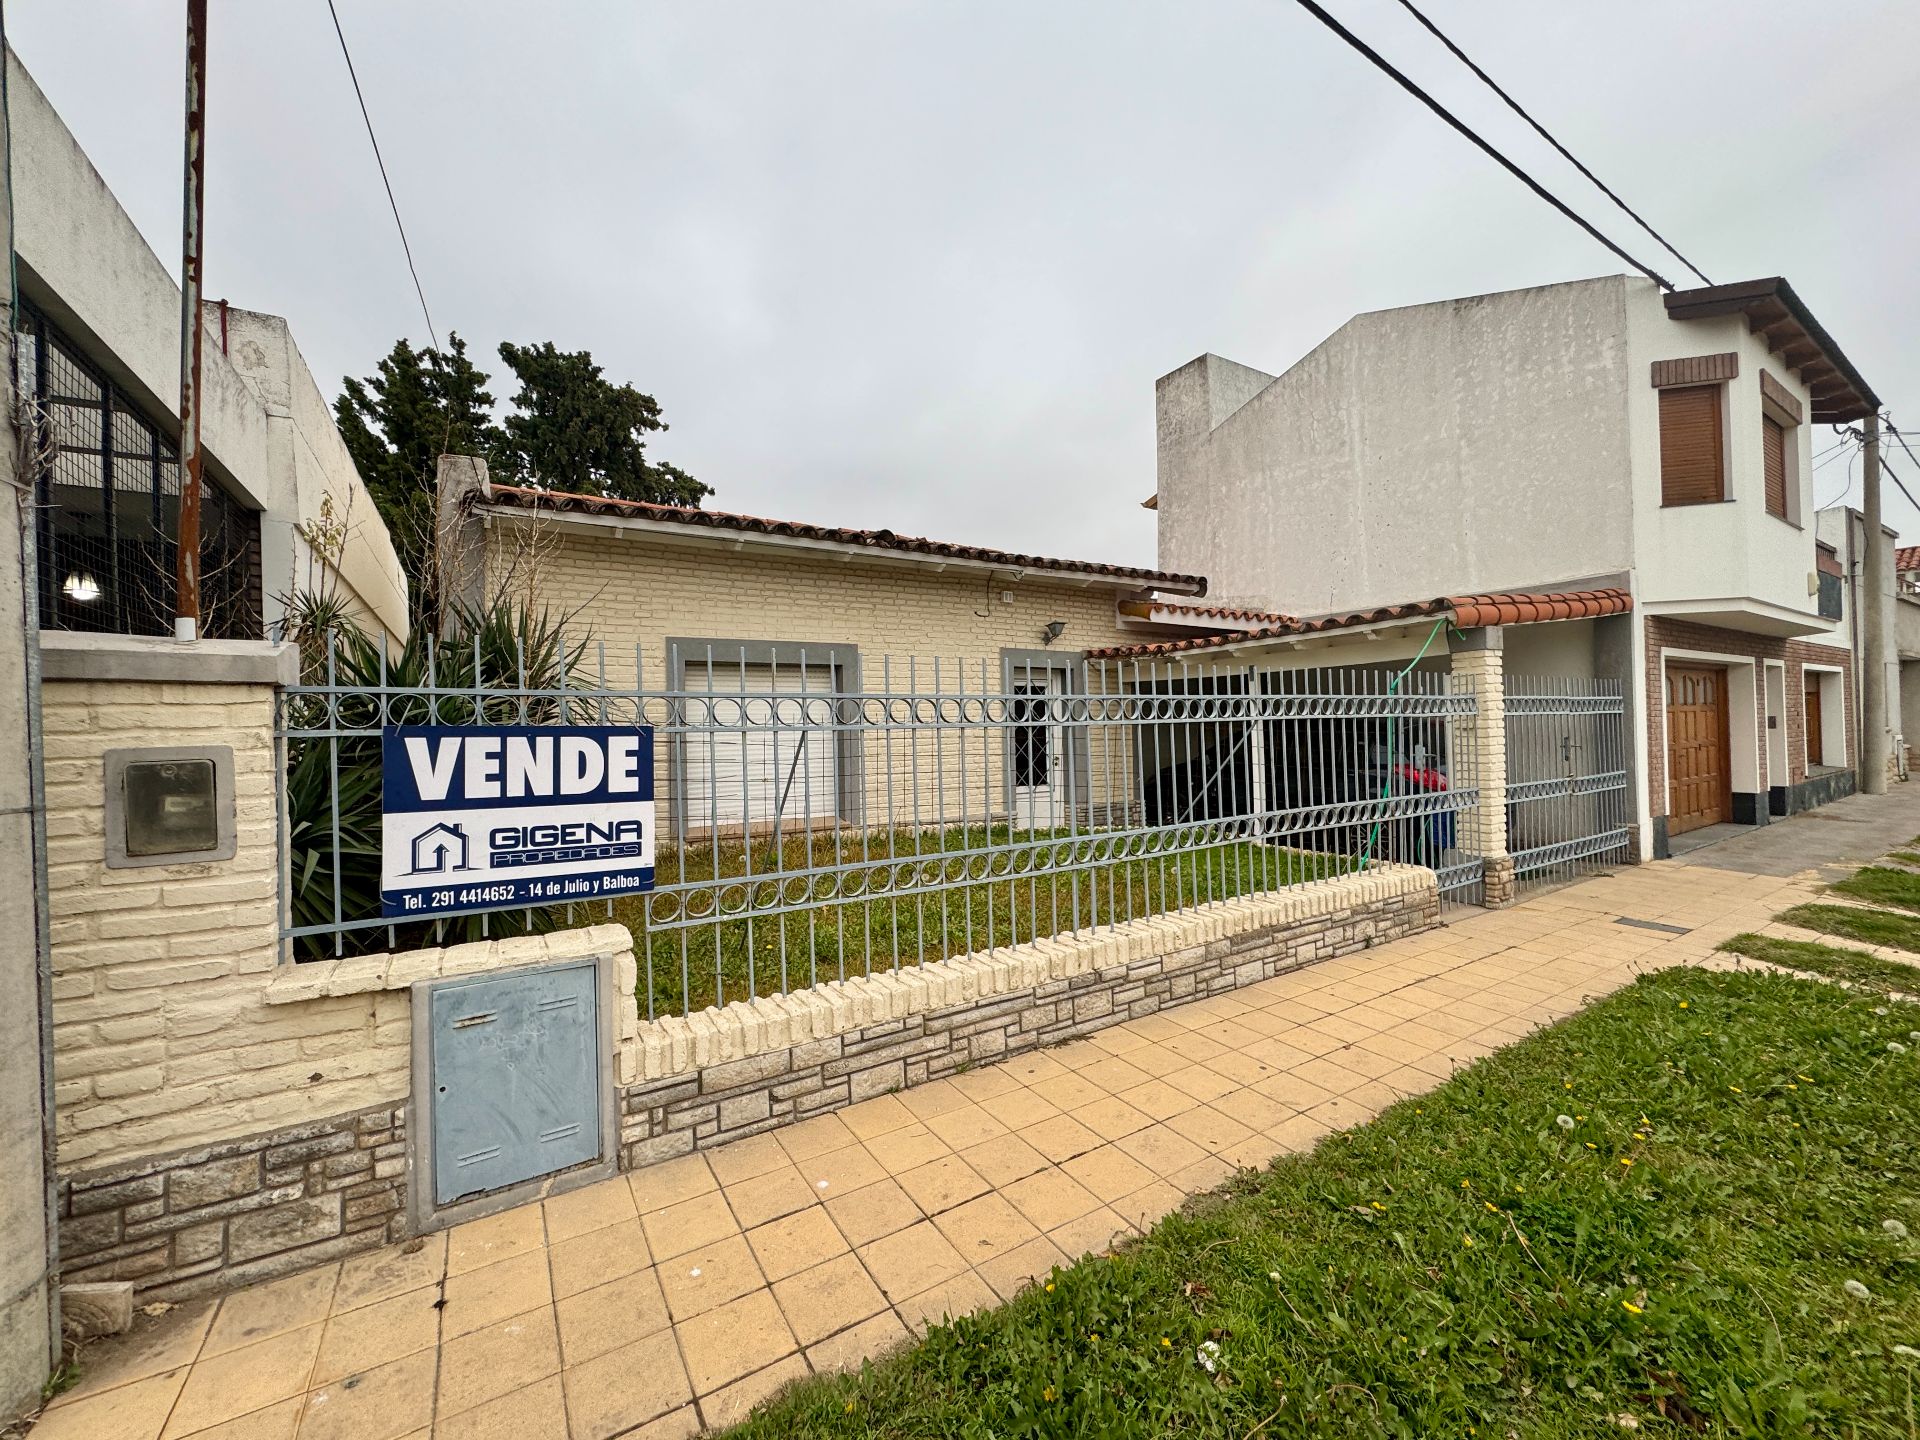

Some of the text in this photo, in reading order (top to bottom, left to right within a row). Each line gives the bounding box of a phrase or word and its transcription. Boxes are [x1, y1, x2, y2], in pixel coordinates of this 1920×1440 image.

[404, 735, 639, 801] VENDE
[489, 820, 642, 850] GIGENA
[493, 844, 639, 866] PROPIEDADES
[402, 894, 427, 910] Tel.
[431, 891, 455, 907] 291
[460, 885, 515, 904] 4414652
[528, 883, 543, 897] 14
[546, 881, 561, 896] de
[563, 879, 590, 894] Julio
[592, 880, 600, 893] y
[603, 875, 640, 890] Balboa
